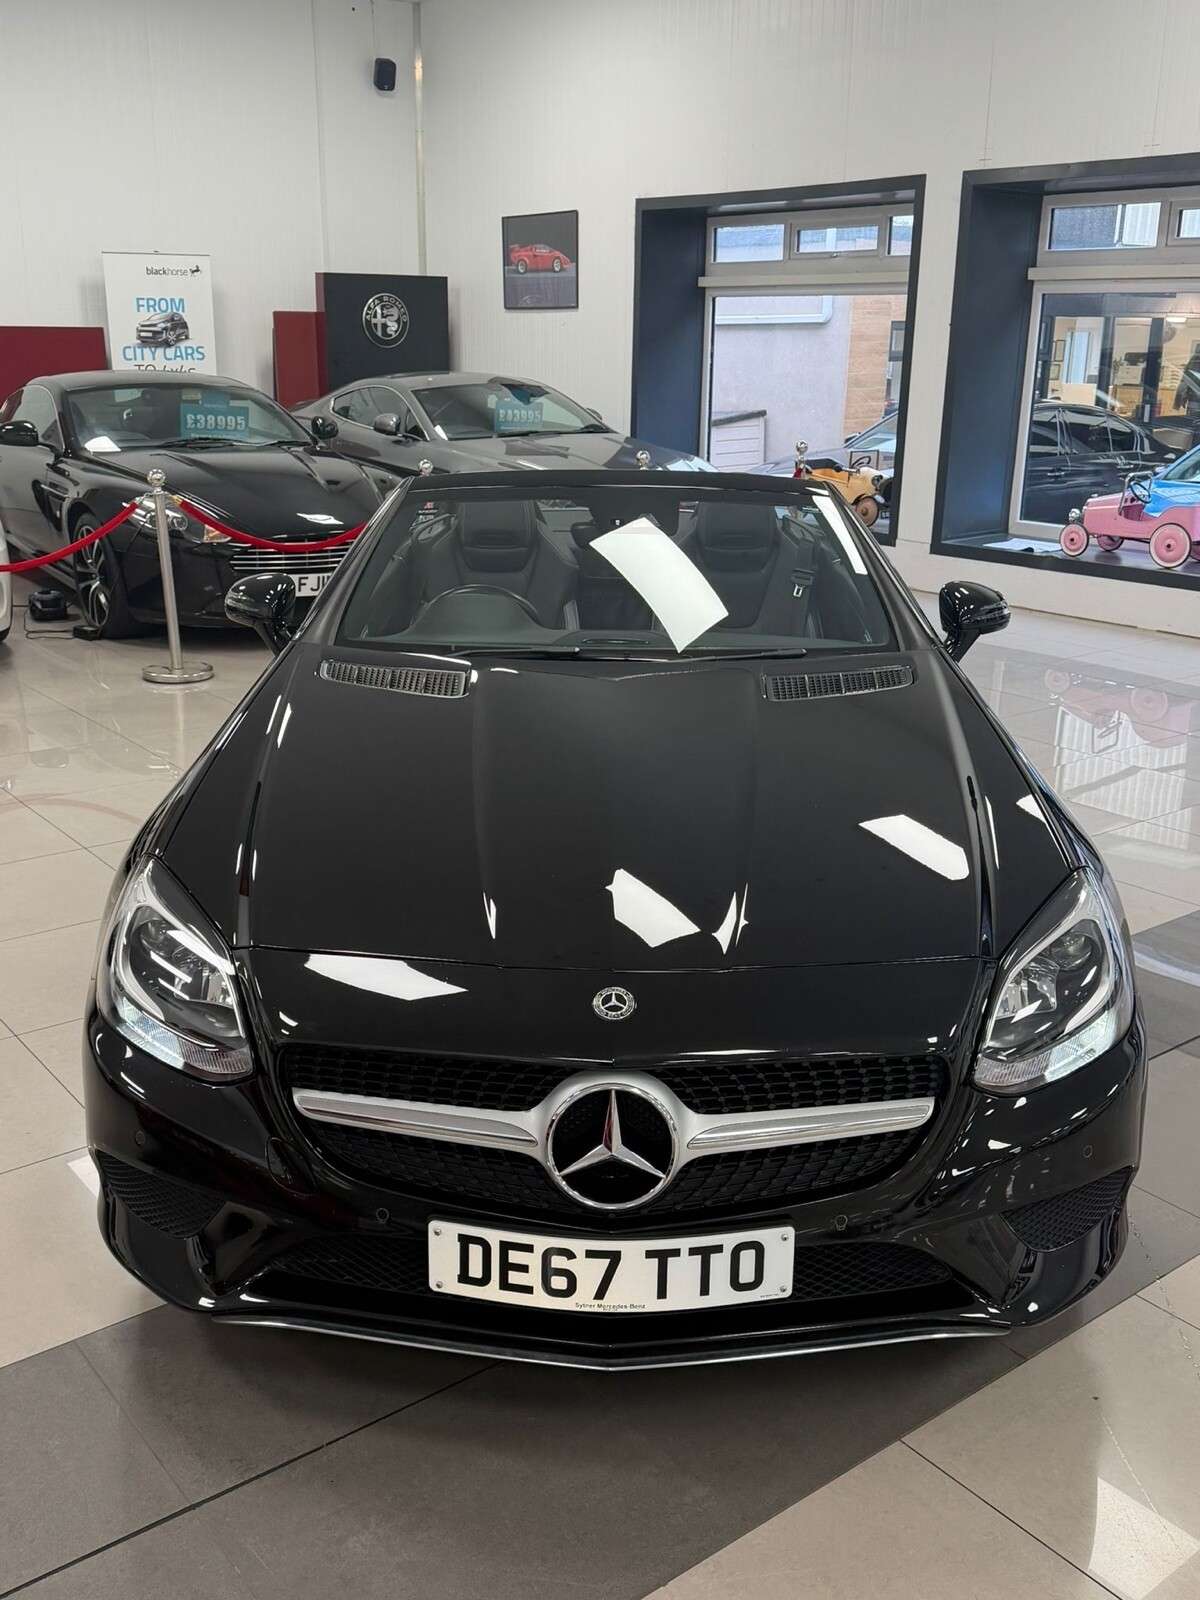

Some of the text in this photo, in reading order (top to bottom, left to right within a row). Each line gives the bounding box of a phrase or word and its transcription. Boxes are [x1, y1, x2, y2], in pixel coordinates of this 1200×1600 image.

[145, 265, 188, 276] blackhorse
[136, 297, 185, 313] FROM
[366, 296, 407, 322] ALFA ROMEO
[123, 346, 206, 361] CITY CARS
[186, 414, 246, 430] £38995
[457, 1232, 766, 1301] DE67 TTO
